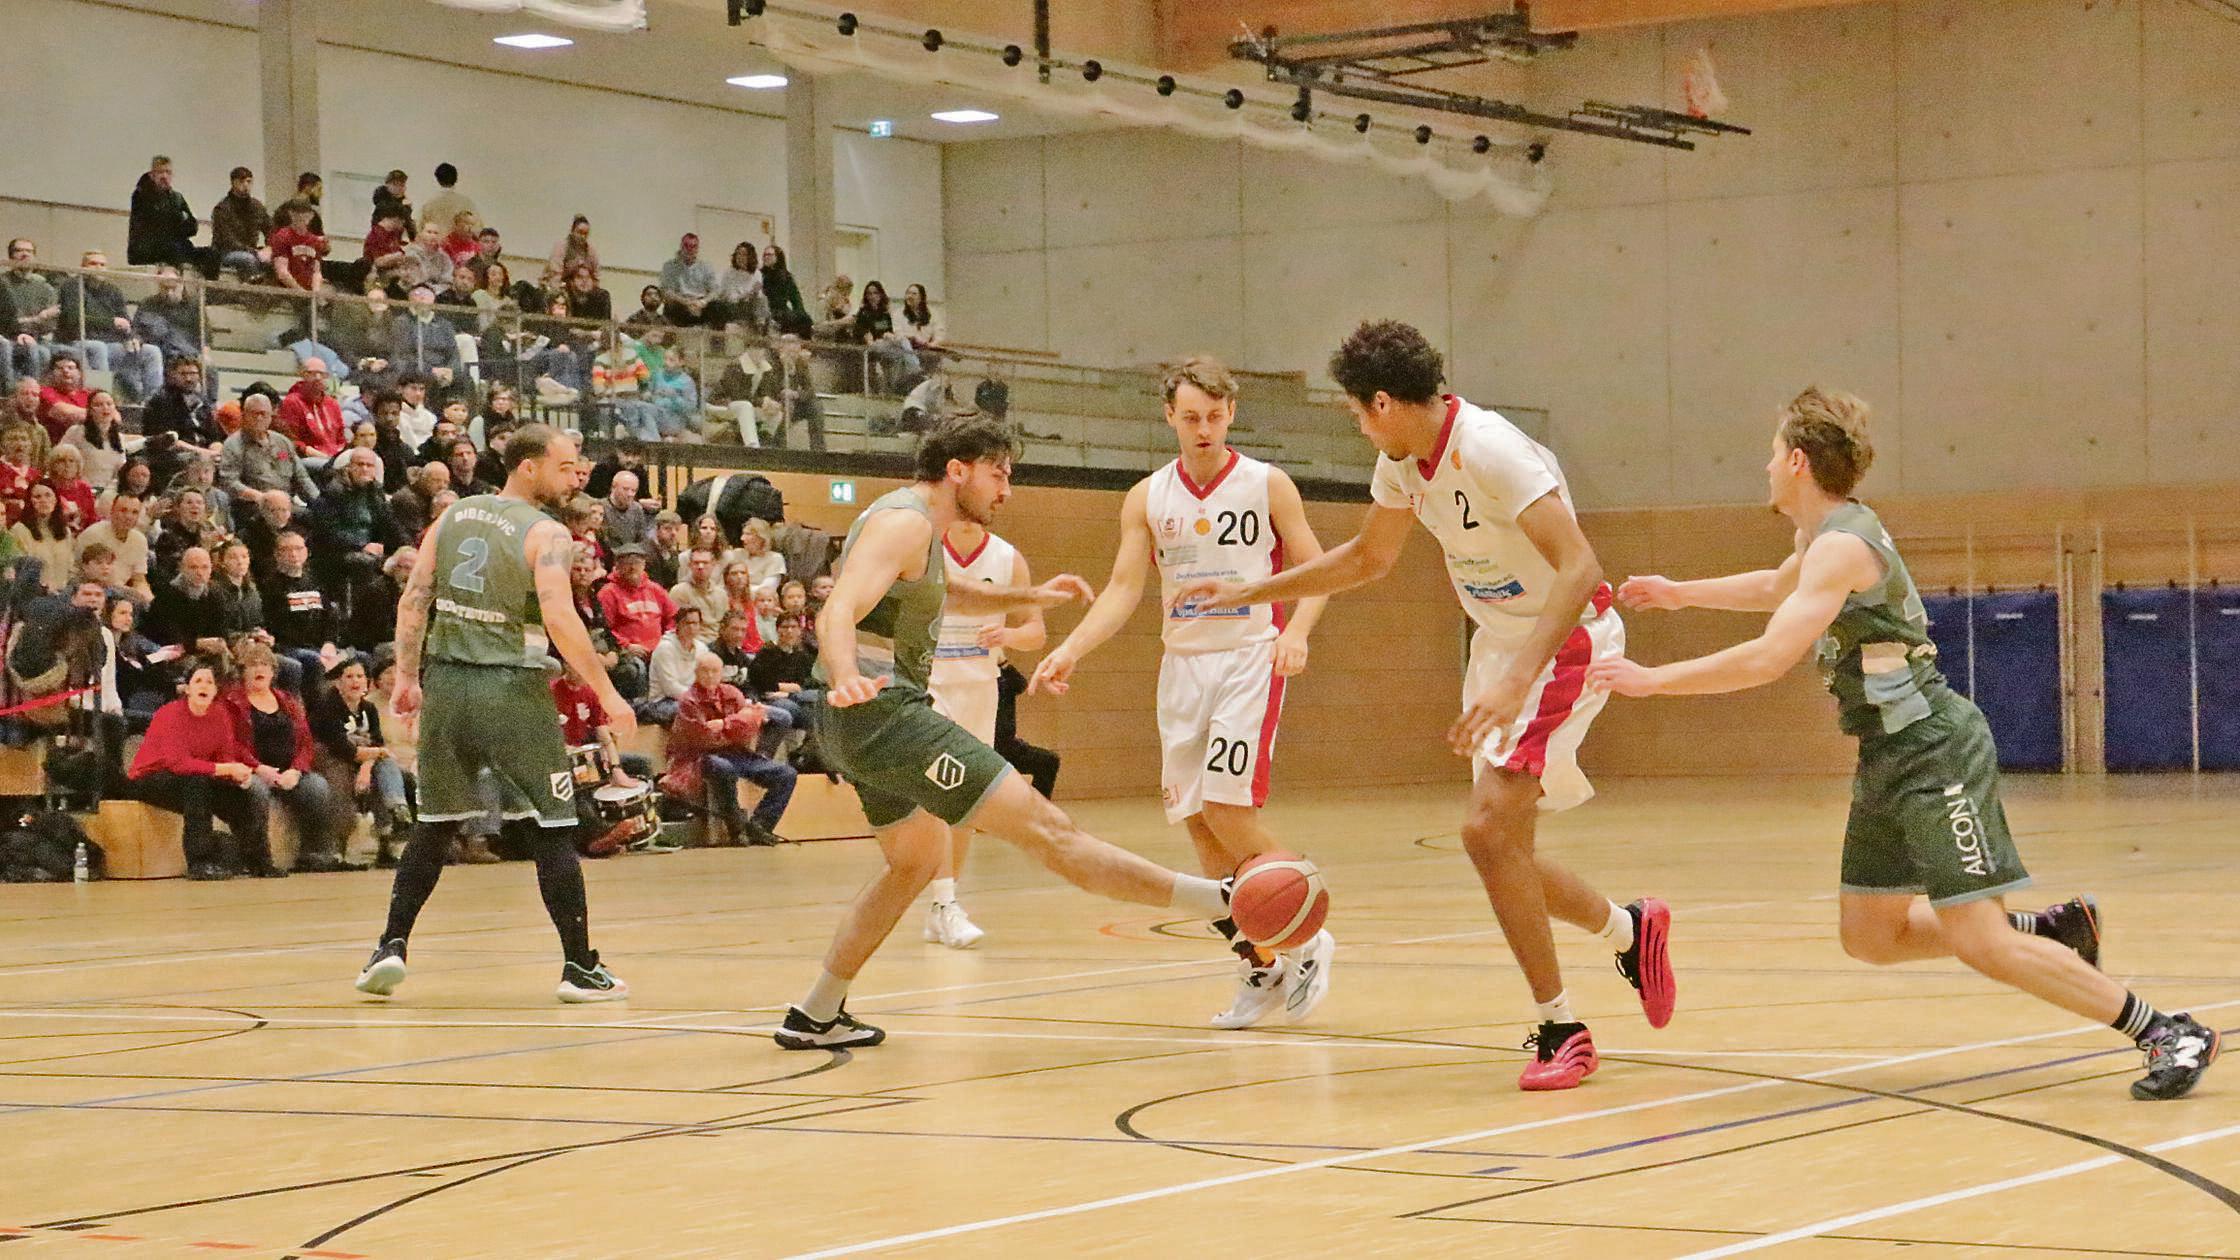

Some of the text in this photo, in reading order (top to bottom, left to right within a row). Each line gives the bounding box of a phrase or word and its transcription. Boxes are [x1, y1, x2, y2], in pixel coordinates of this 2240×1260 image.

[1217, 510, 1260, 546] 20
[1454, 490, 1480, 530] 2
[449, 536, 489, 593] 2
[1206, 737, 1249, 776] 20
